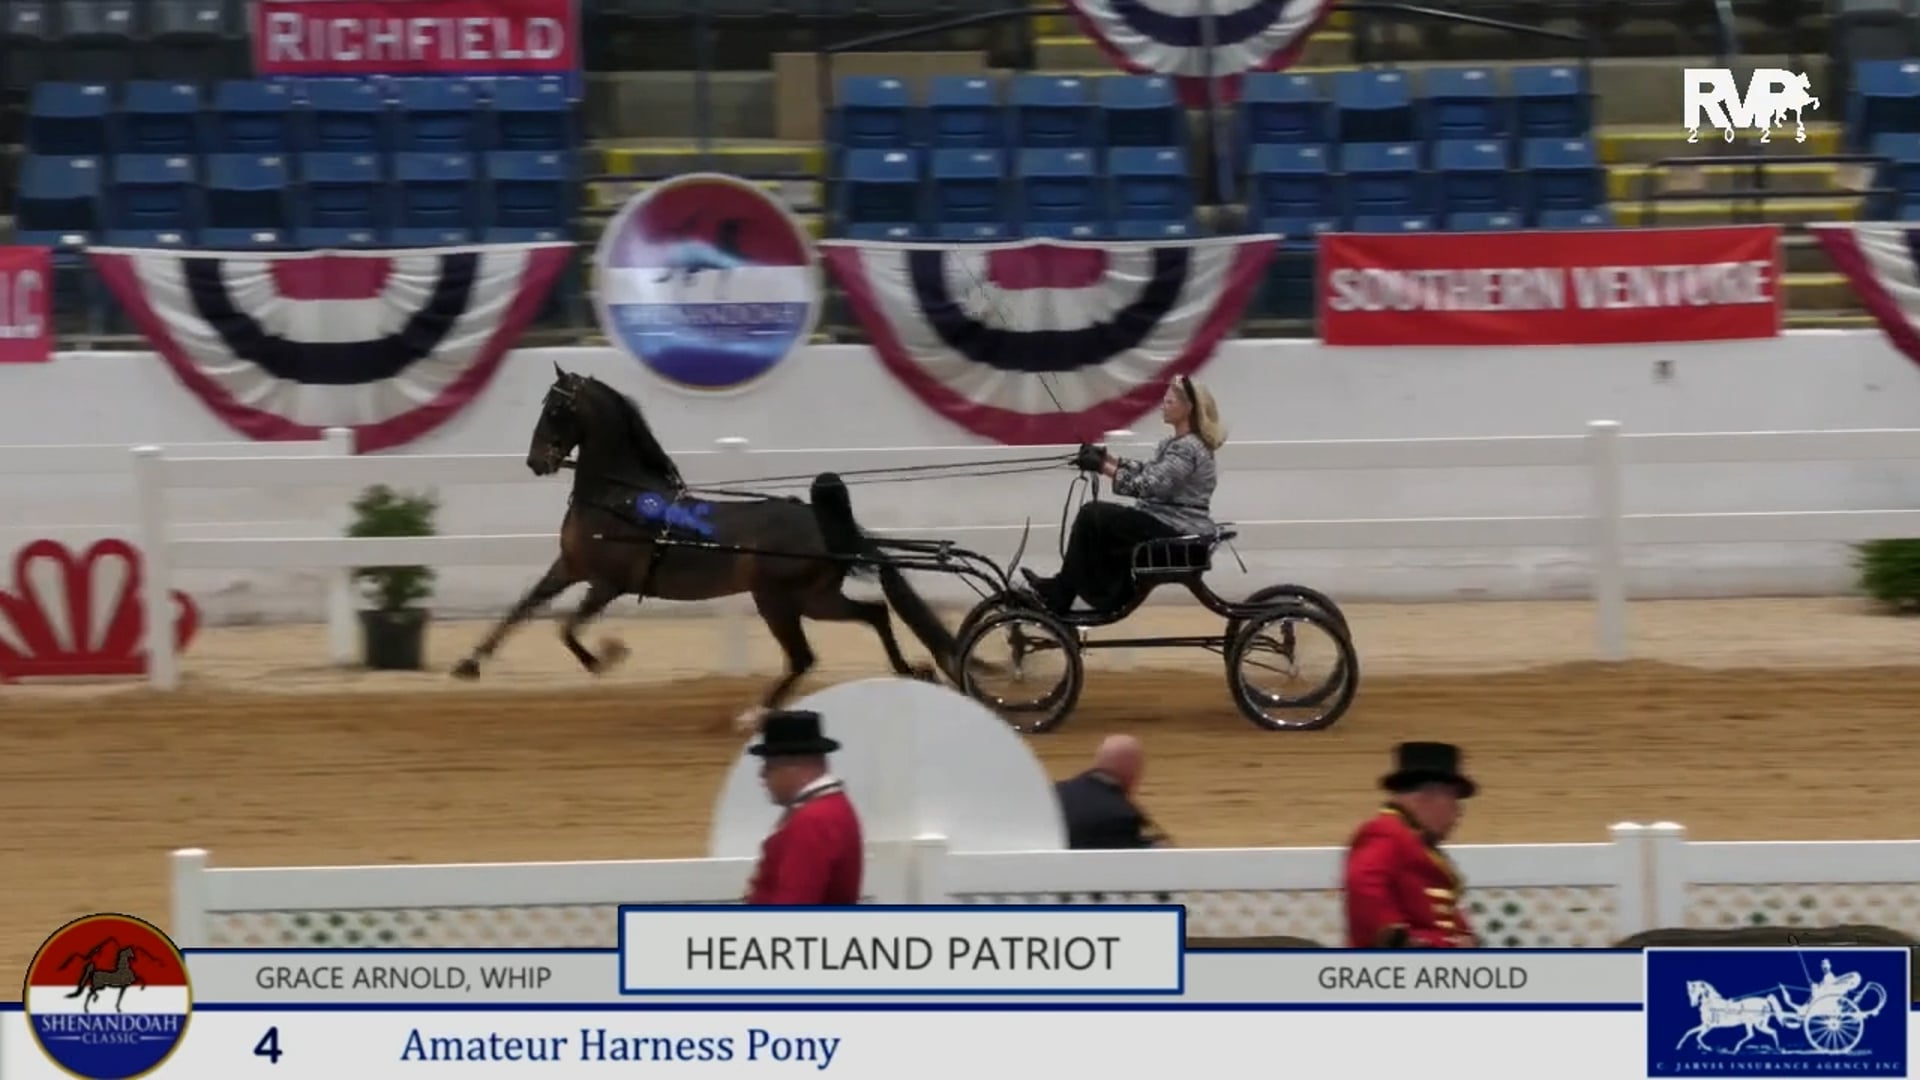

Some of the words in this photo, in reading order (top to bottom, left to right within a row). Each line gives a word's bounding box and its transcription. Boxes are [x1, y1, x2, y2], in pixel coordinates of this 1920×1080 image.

[265, 11, 565, 61] RICHFIELD
[1328, 267, 1566, 312] SOUTHERN
[1571, 260, 1773, 309] VENTURE
